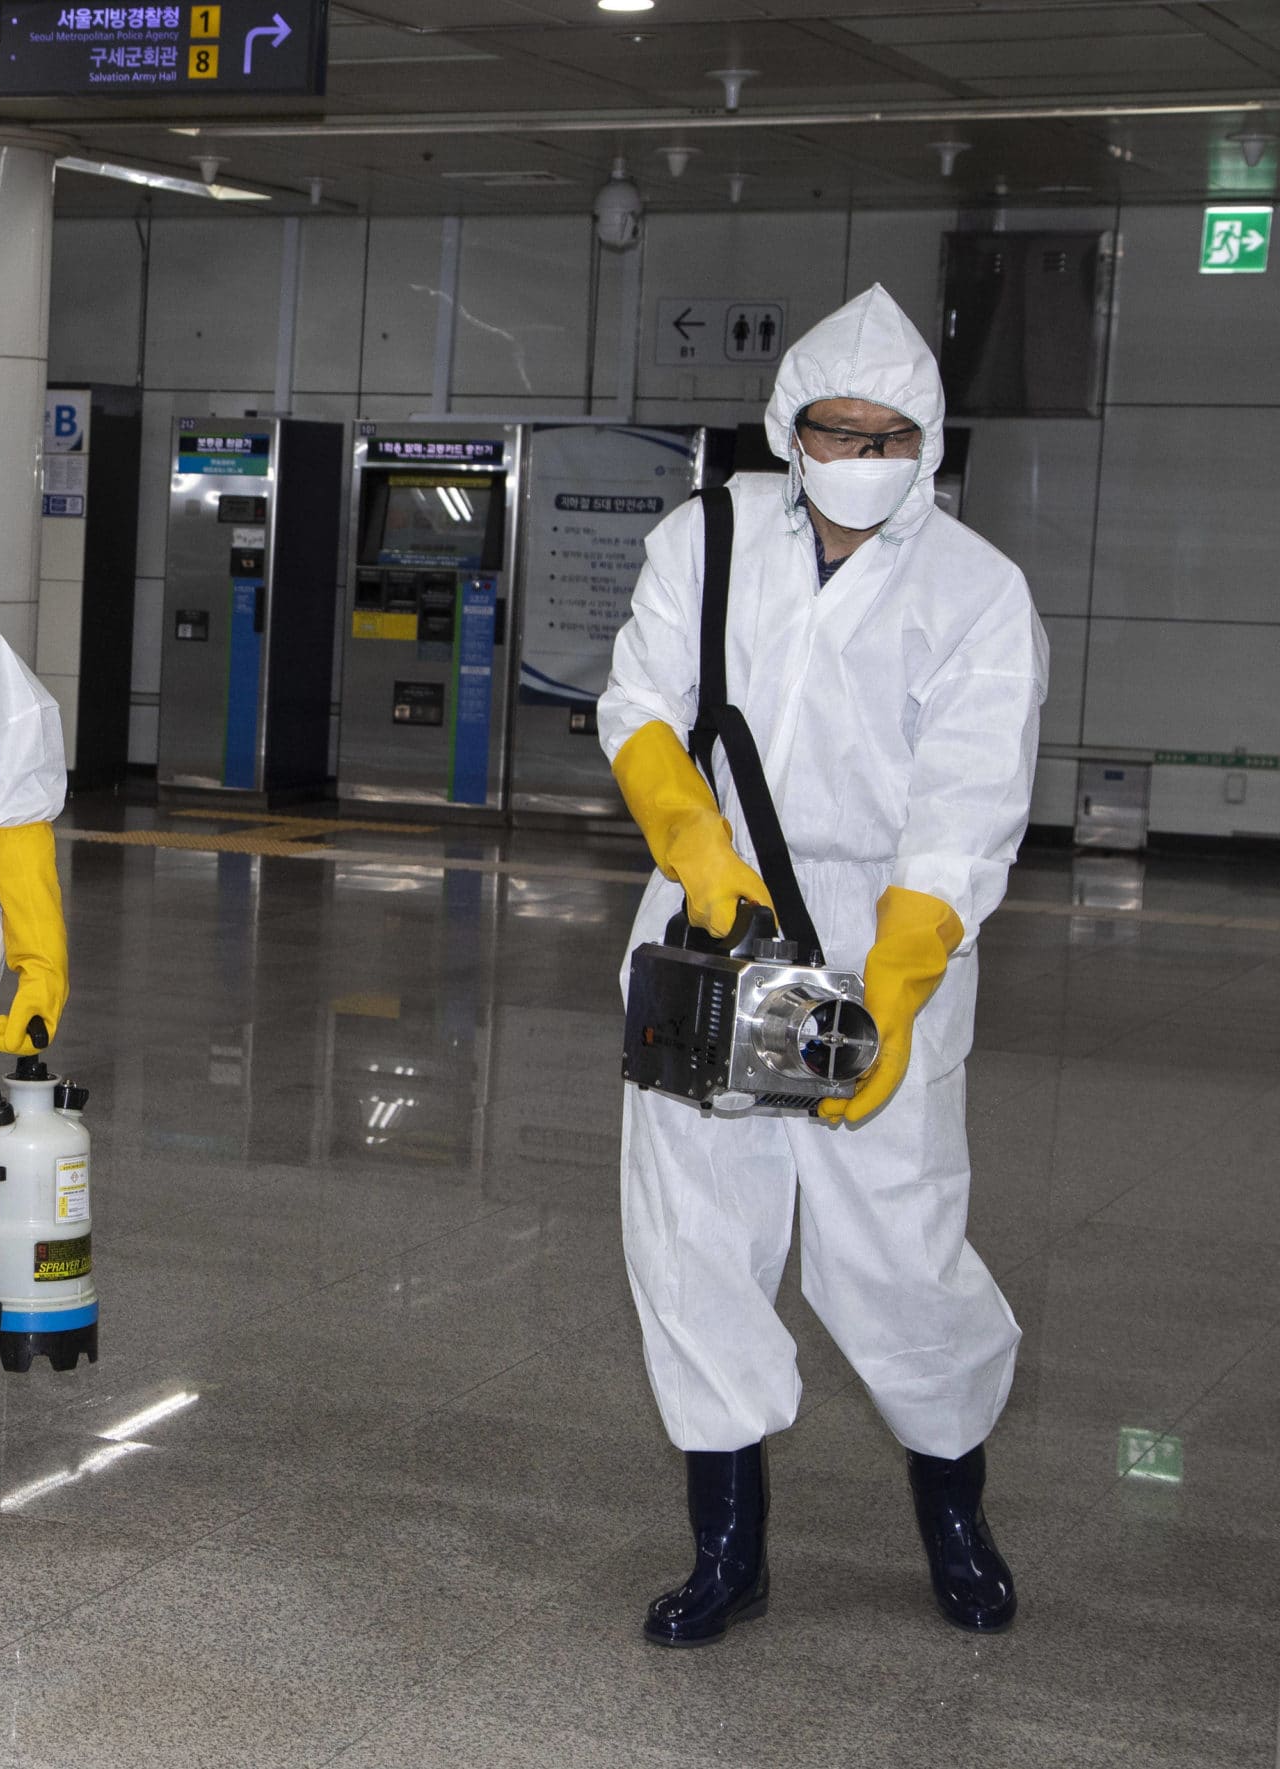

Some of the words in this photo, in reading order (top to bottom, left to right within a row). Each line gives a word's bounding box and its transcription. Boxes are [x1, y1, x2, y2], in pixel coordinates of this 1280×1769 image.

[57, 6, 180, 30] 서울지방경찰청
[199, 11, 209, 33] 1
[29, 31, 53, 42] Seoul
[56, 32, 115, 42] Metropolitan
[117, 31, 143, 40] Police
[146, 31, 179, 42] Agency
[90, 46, 178, 68] 구세군회관
[196, 51, 210, 73] 8
[89, 72, 130, 82] Salvation
[132, 72, 157, 83] Army
[159, 71, 177, 81] Hall
[55, 404, 77, 437] B
[39, 1260, 81, 1273] SPRAYER
